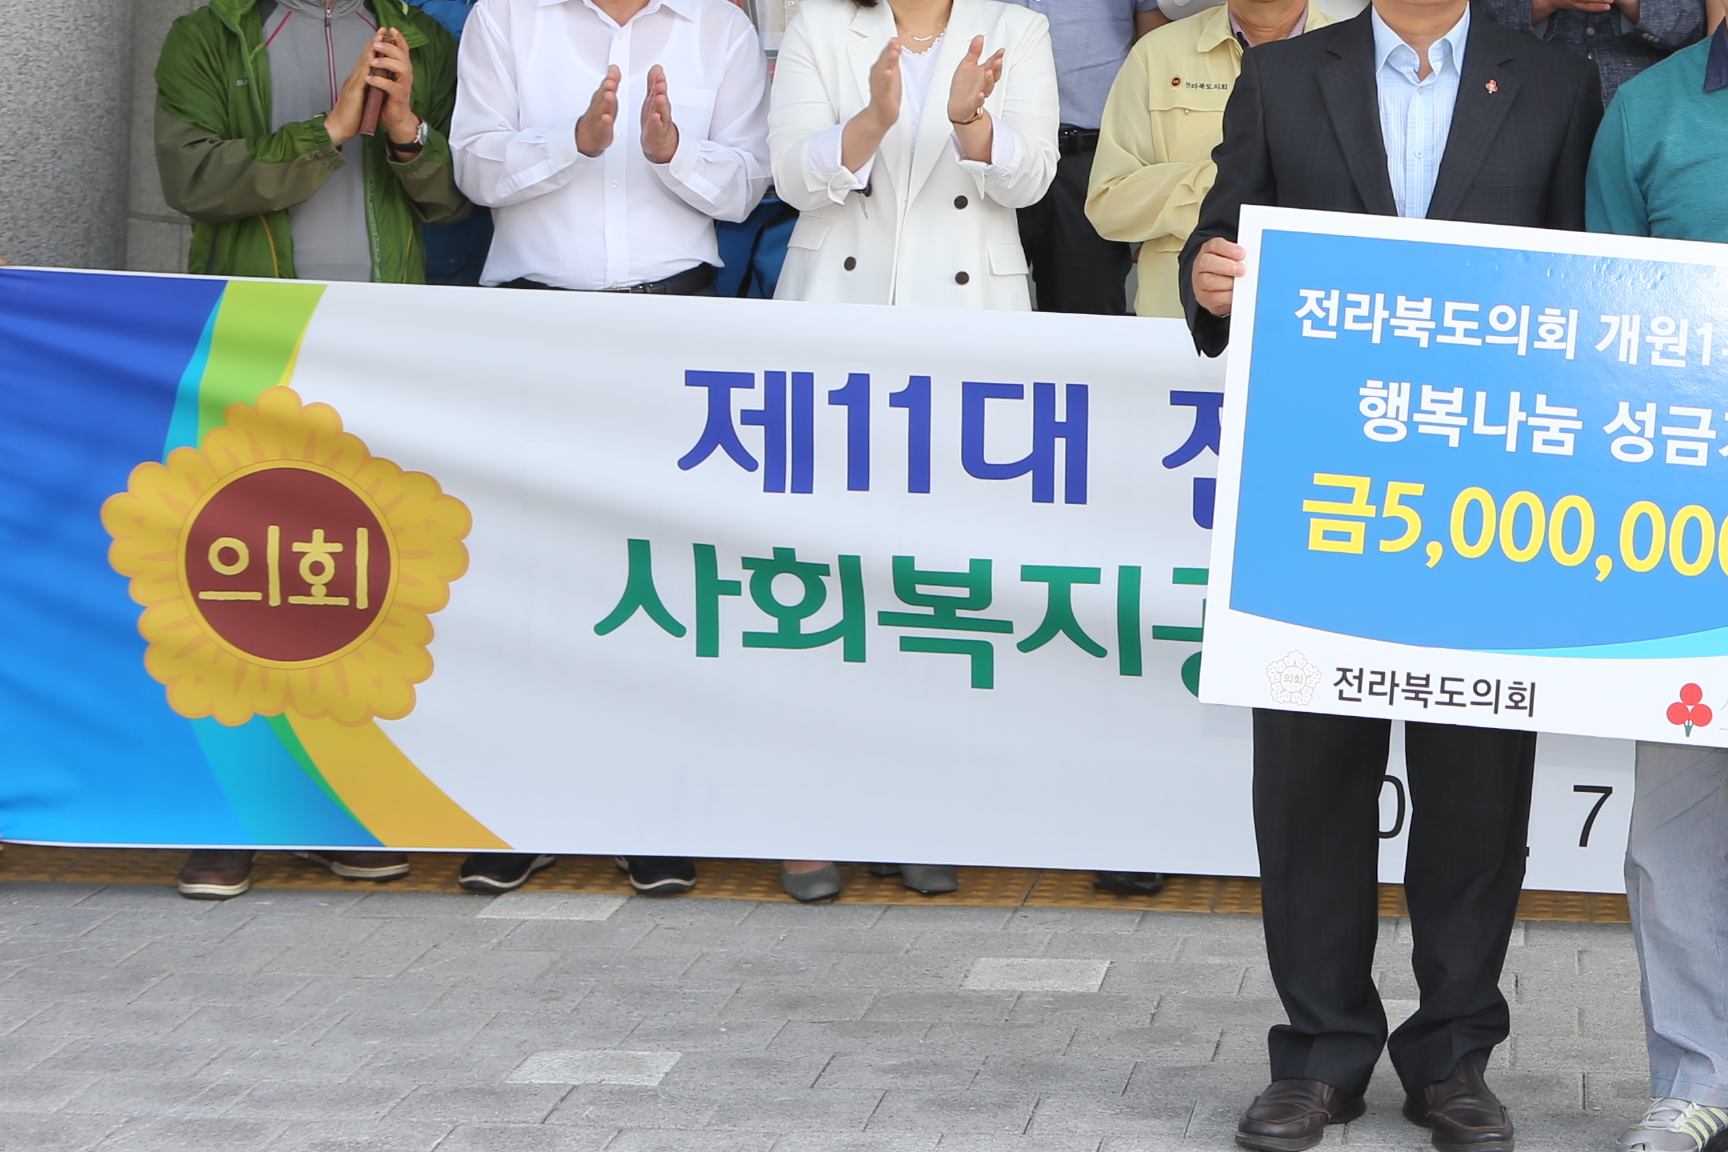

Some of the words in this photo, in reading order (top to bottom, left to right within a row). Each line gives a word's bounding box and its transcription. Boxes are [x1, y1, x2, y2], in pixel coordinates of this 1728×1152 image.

[1293, 288, 1579, 360] 전라북도의회
[676, 369, 1089, 505] 제11대
[1358, 379, 1584, 457] 행복나눔
[198, 525, 370, 611] 의회
[1332, 664, 1537, 718] 전라북도의회
